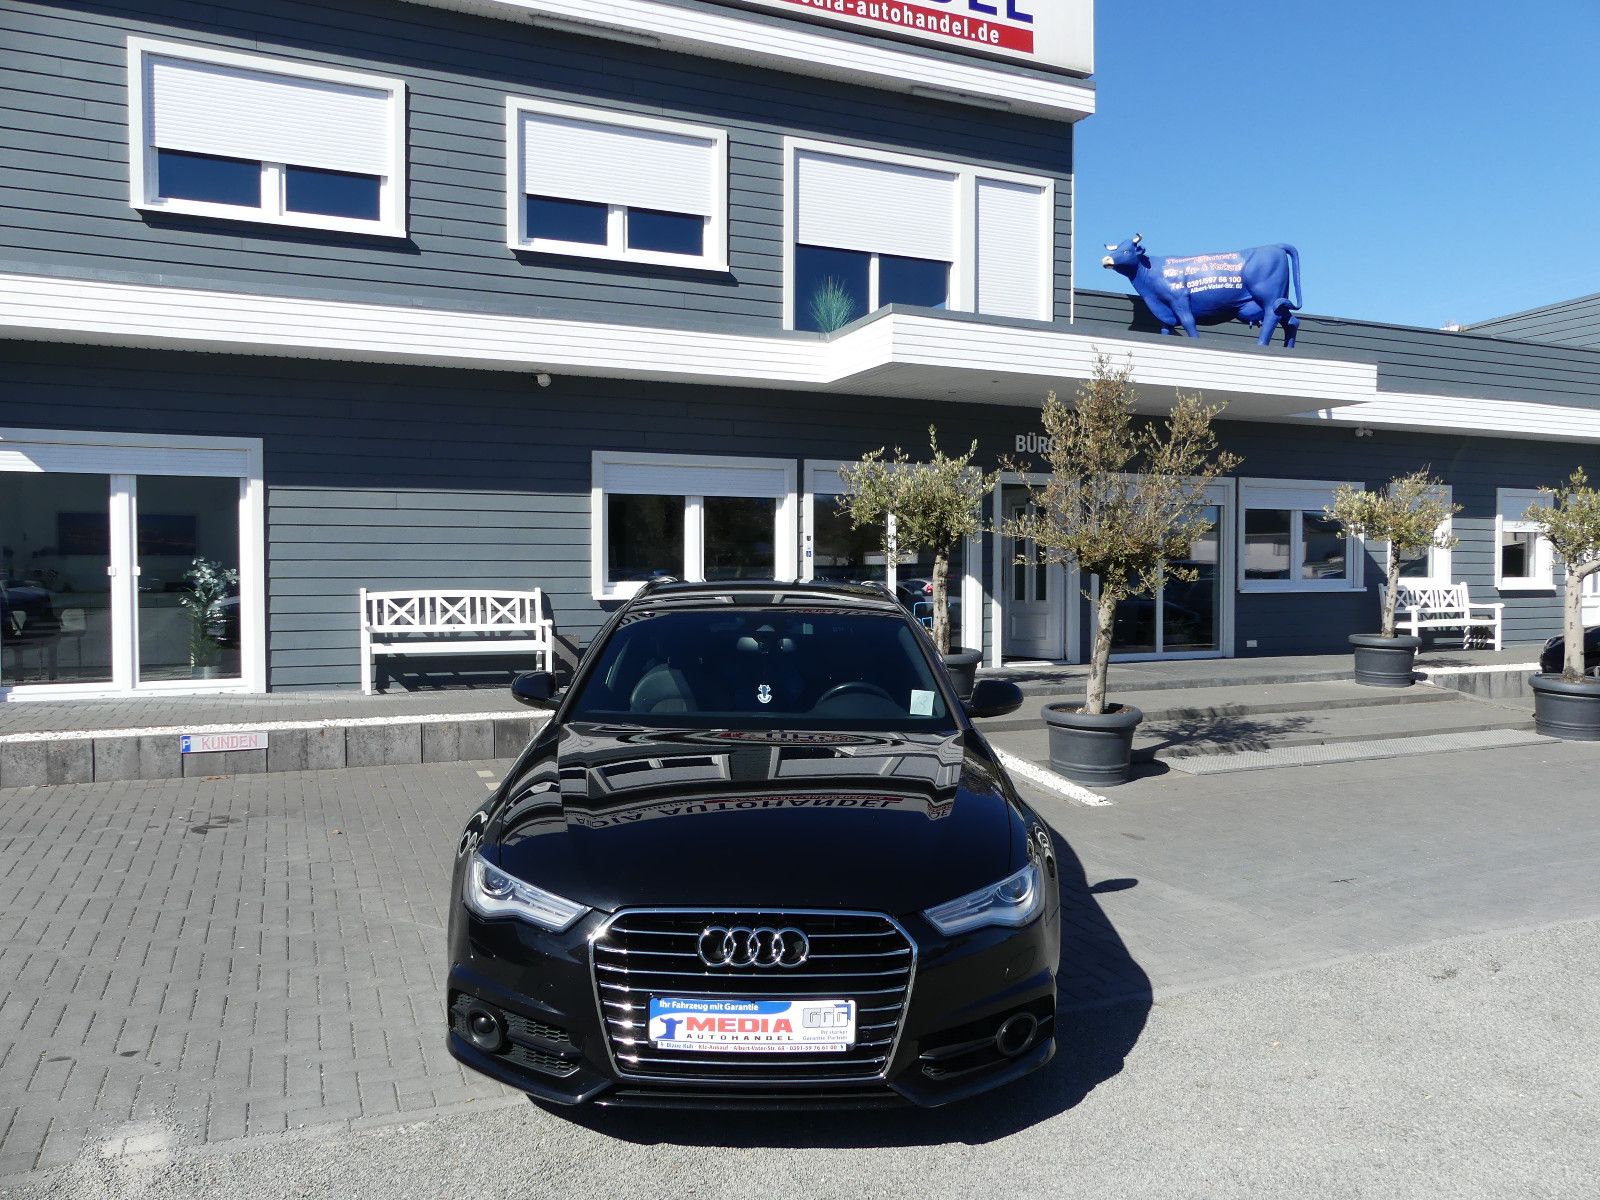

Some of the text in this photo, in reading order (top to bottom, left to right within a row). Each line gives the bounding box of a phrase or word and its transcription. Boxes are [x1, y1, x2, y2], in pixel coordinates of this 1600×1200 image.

[801, 0, 999, 44] ia-autohandel.de
[1171, 282, 1185, 290] Tel.
[202, 735, 257, 749] KUNDEN
[659, 1000, 759, 1011] Ihr Fahrzeug mit Garantie
[686, 1017, 793, 1033] MEDIA
[686, 1033, 794, 1041] AUTOHANDEL
